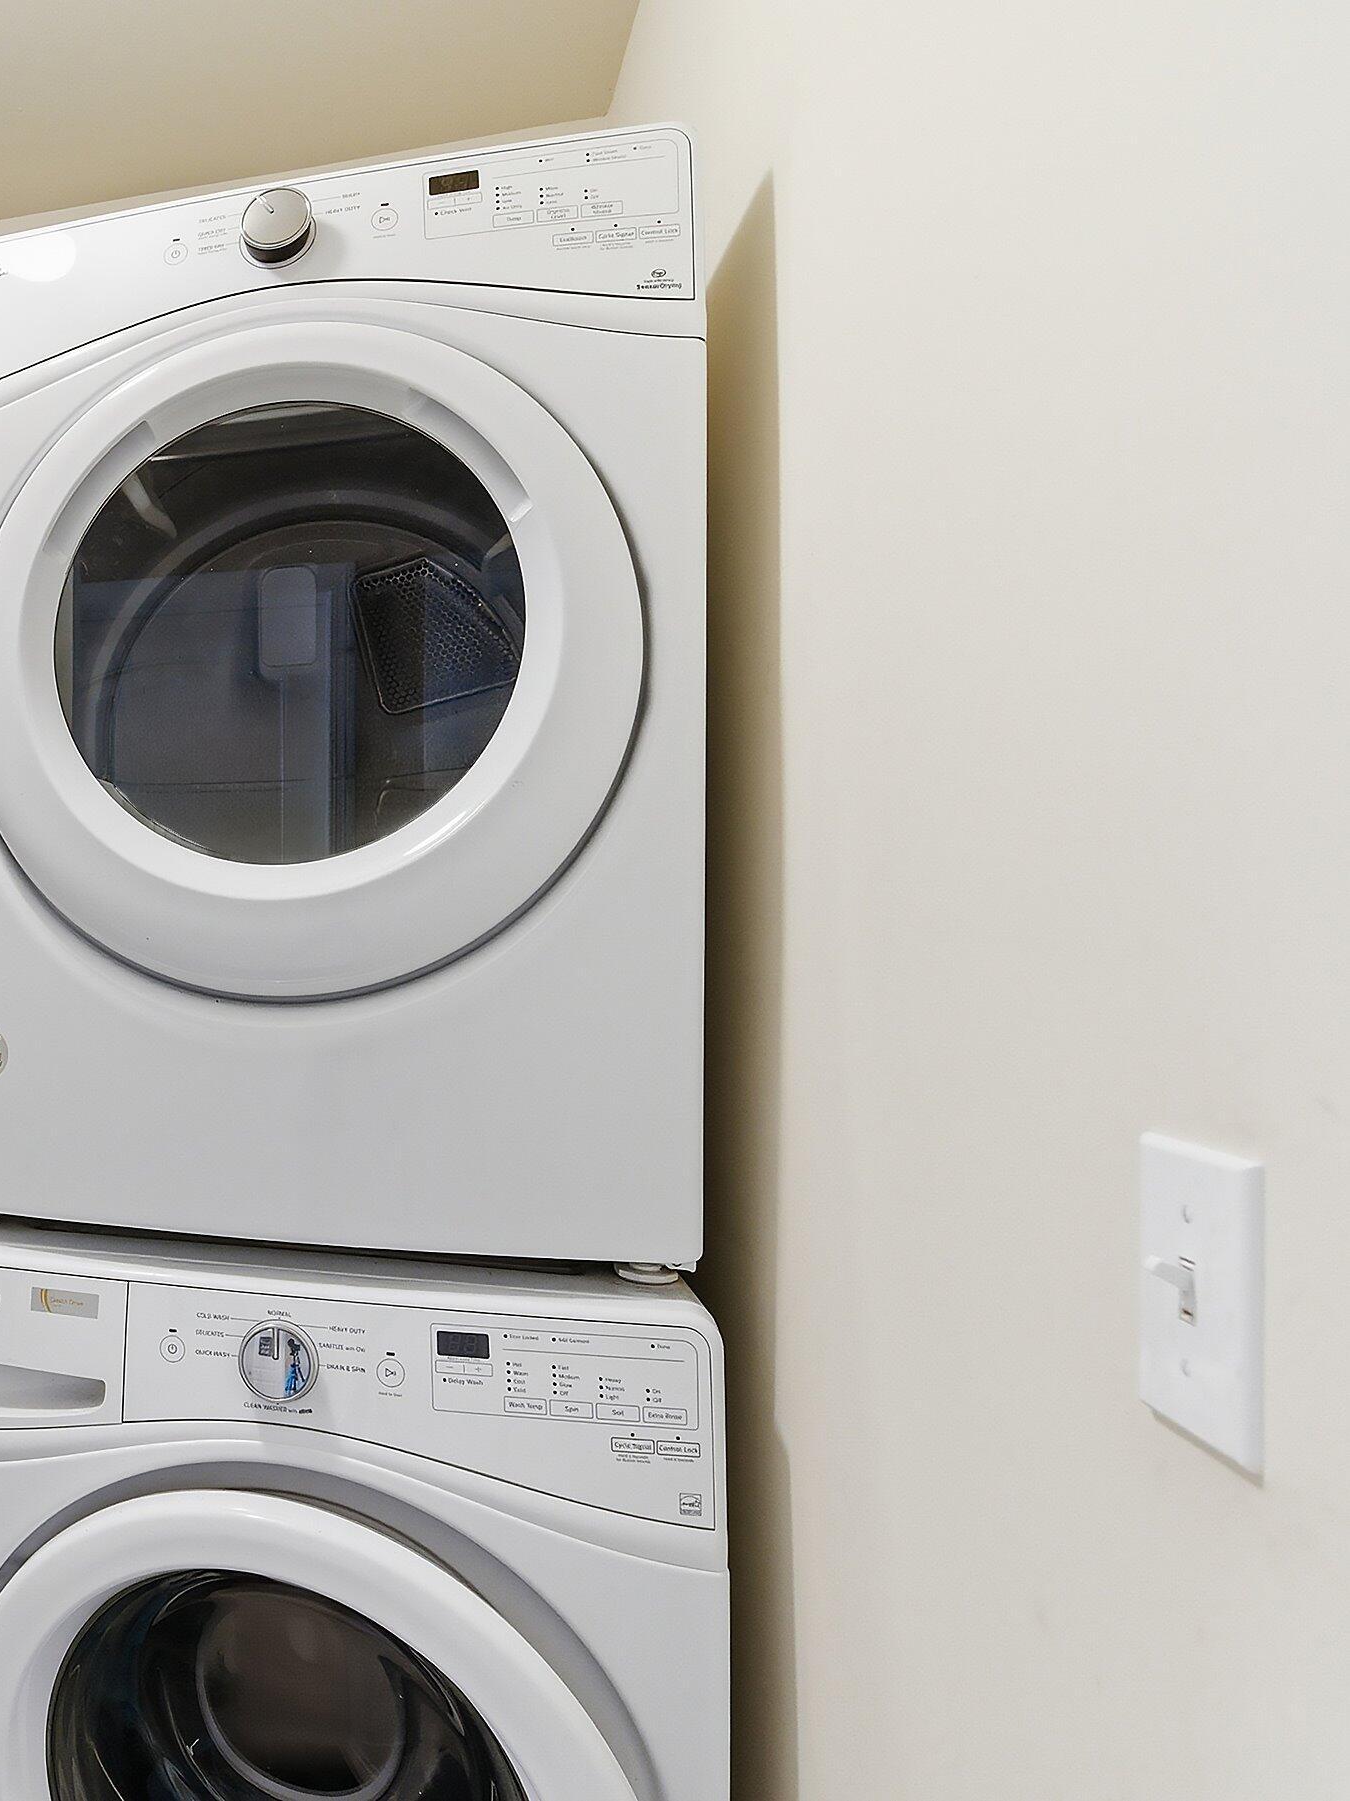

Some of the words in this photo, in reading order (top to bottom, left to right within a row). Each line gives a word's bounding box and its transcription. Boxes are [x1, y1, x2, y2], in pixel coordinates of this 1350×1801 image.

[349, 1327, 367, 1335] DUTY
[448, 1378, 466, 1386] Delay
[243, 1401, 262, 1410] CLEAN
[508, 1401, 526, 1409] Wash
[648, 1412, 664, 1420] Extra
[614, 1442, 631, 1451] Cycle
[659, 1445, 682, 1453] Control
[683, 1446, 698, 1454] Lock
